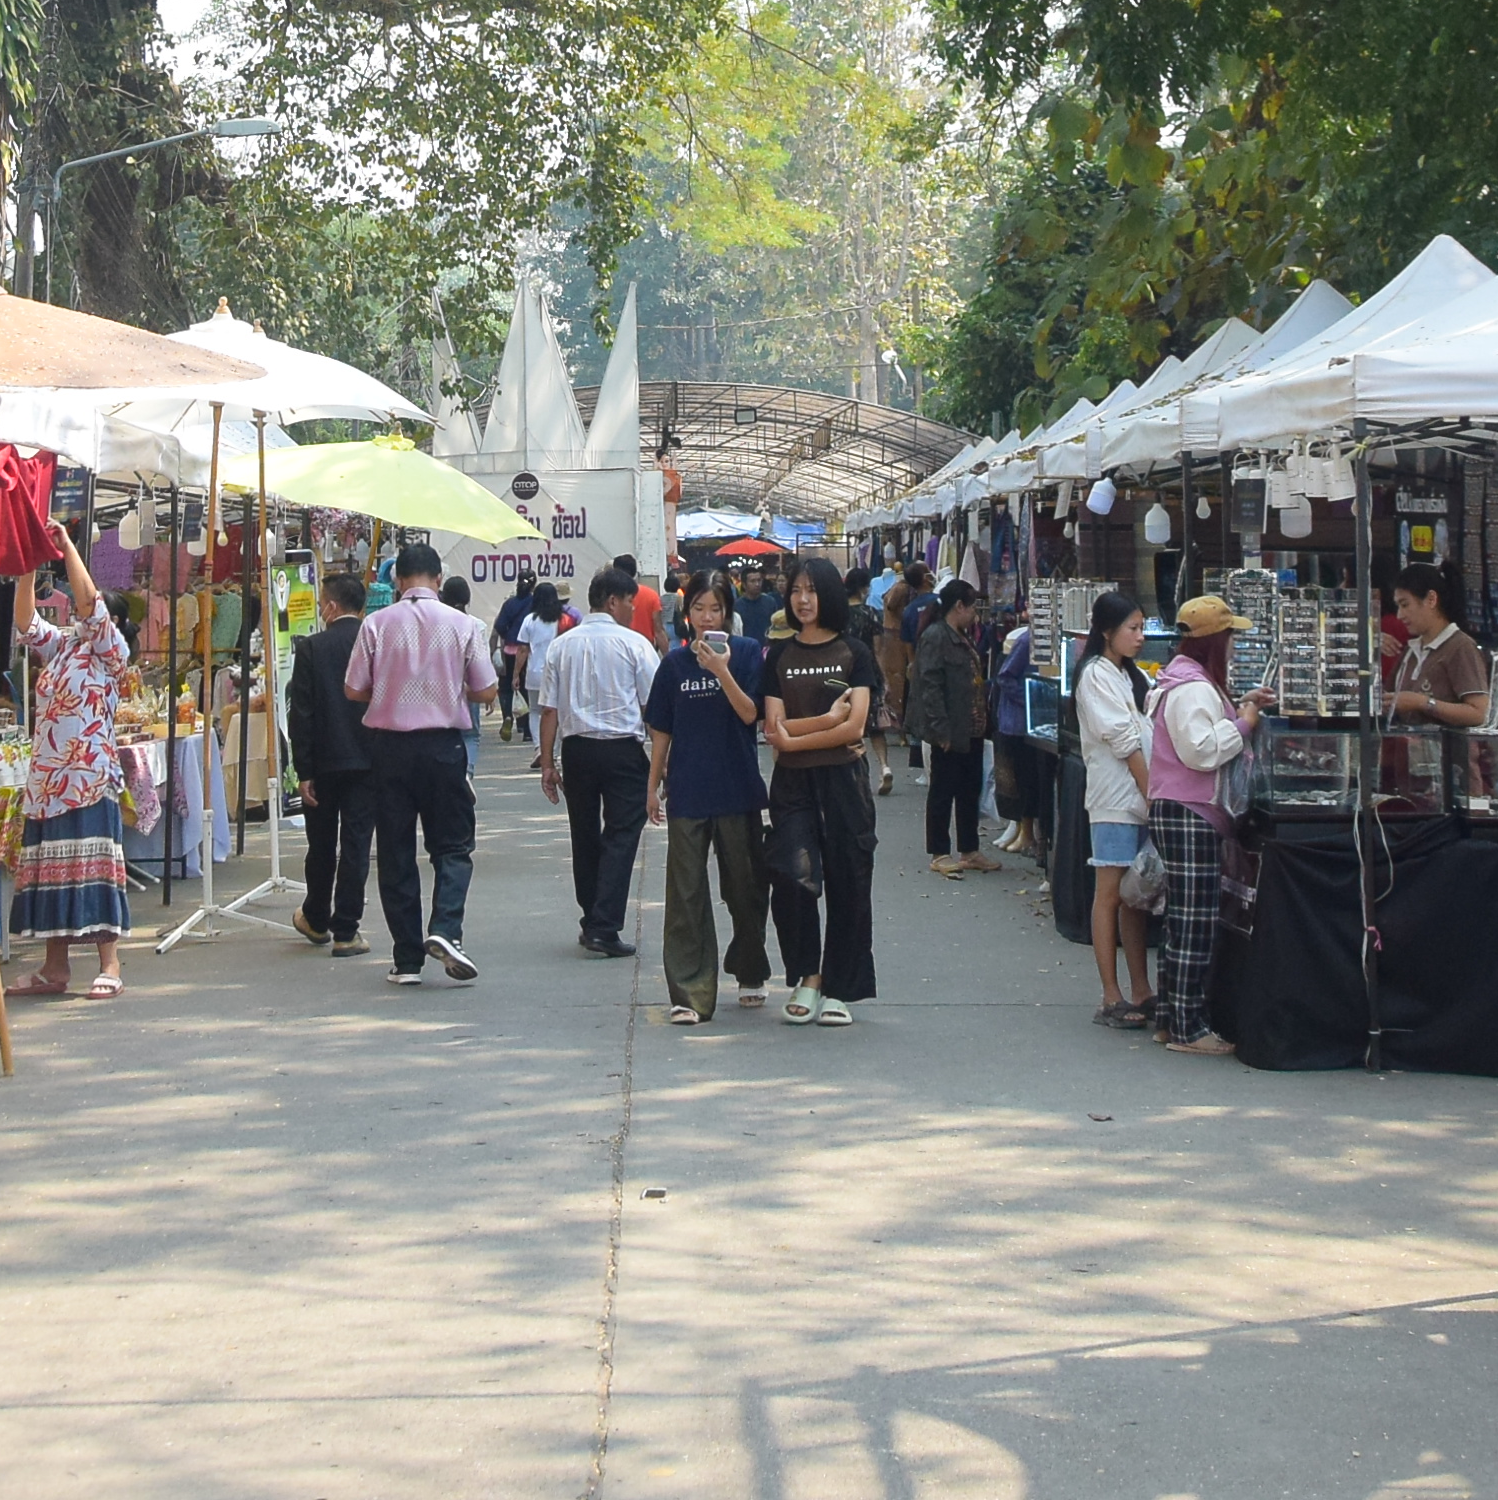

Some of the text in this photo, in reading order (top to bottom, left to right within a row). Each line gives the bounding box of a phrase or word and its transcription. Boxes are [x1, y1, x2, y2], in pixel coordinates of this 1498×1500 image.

[514, 481, 537, 489] OTOP
[552, 503, 587, 540] ช้อป
[537, 540, 575, 578] น่าน
[680, 676, 723, 692] daisy
